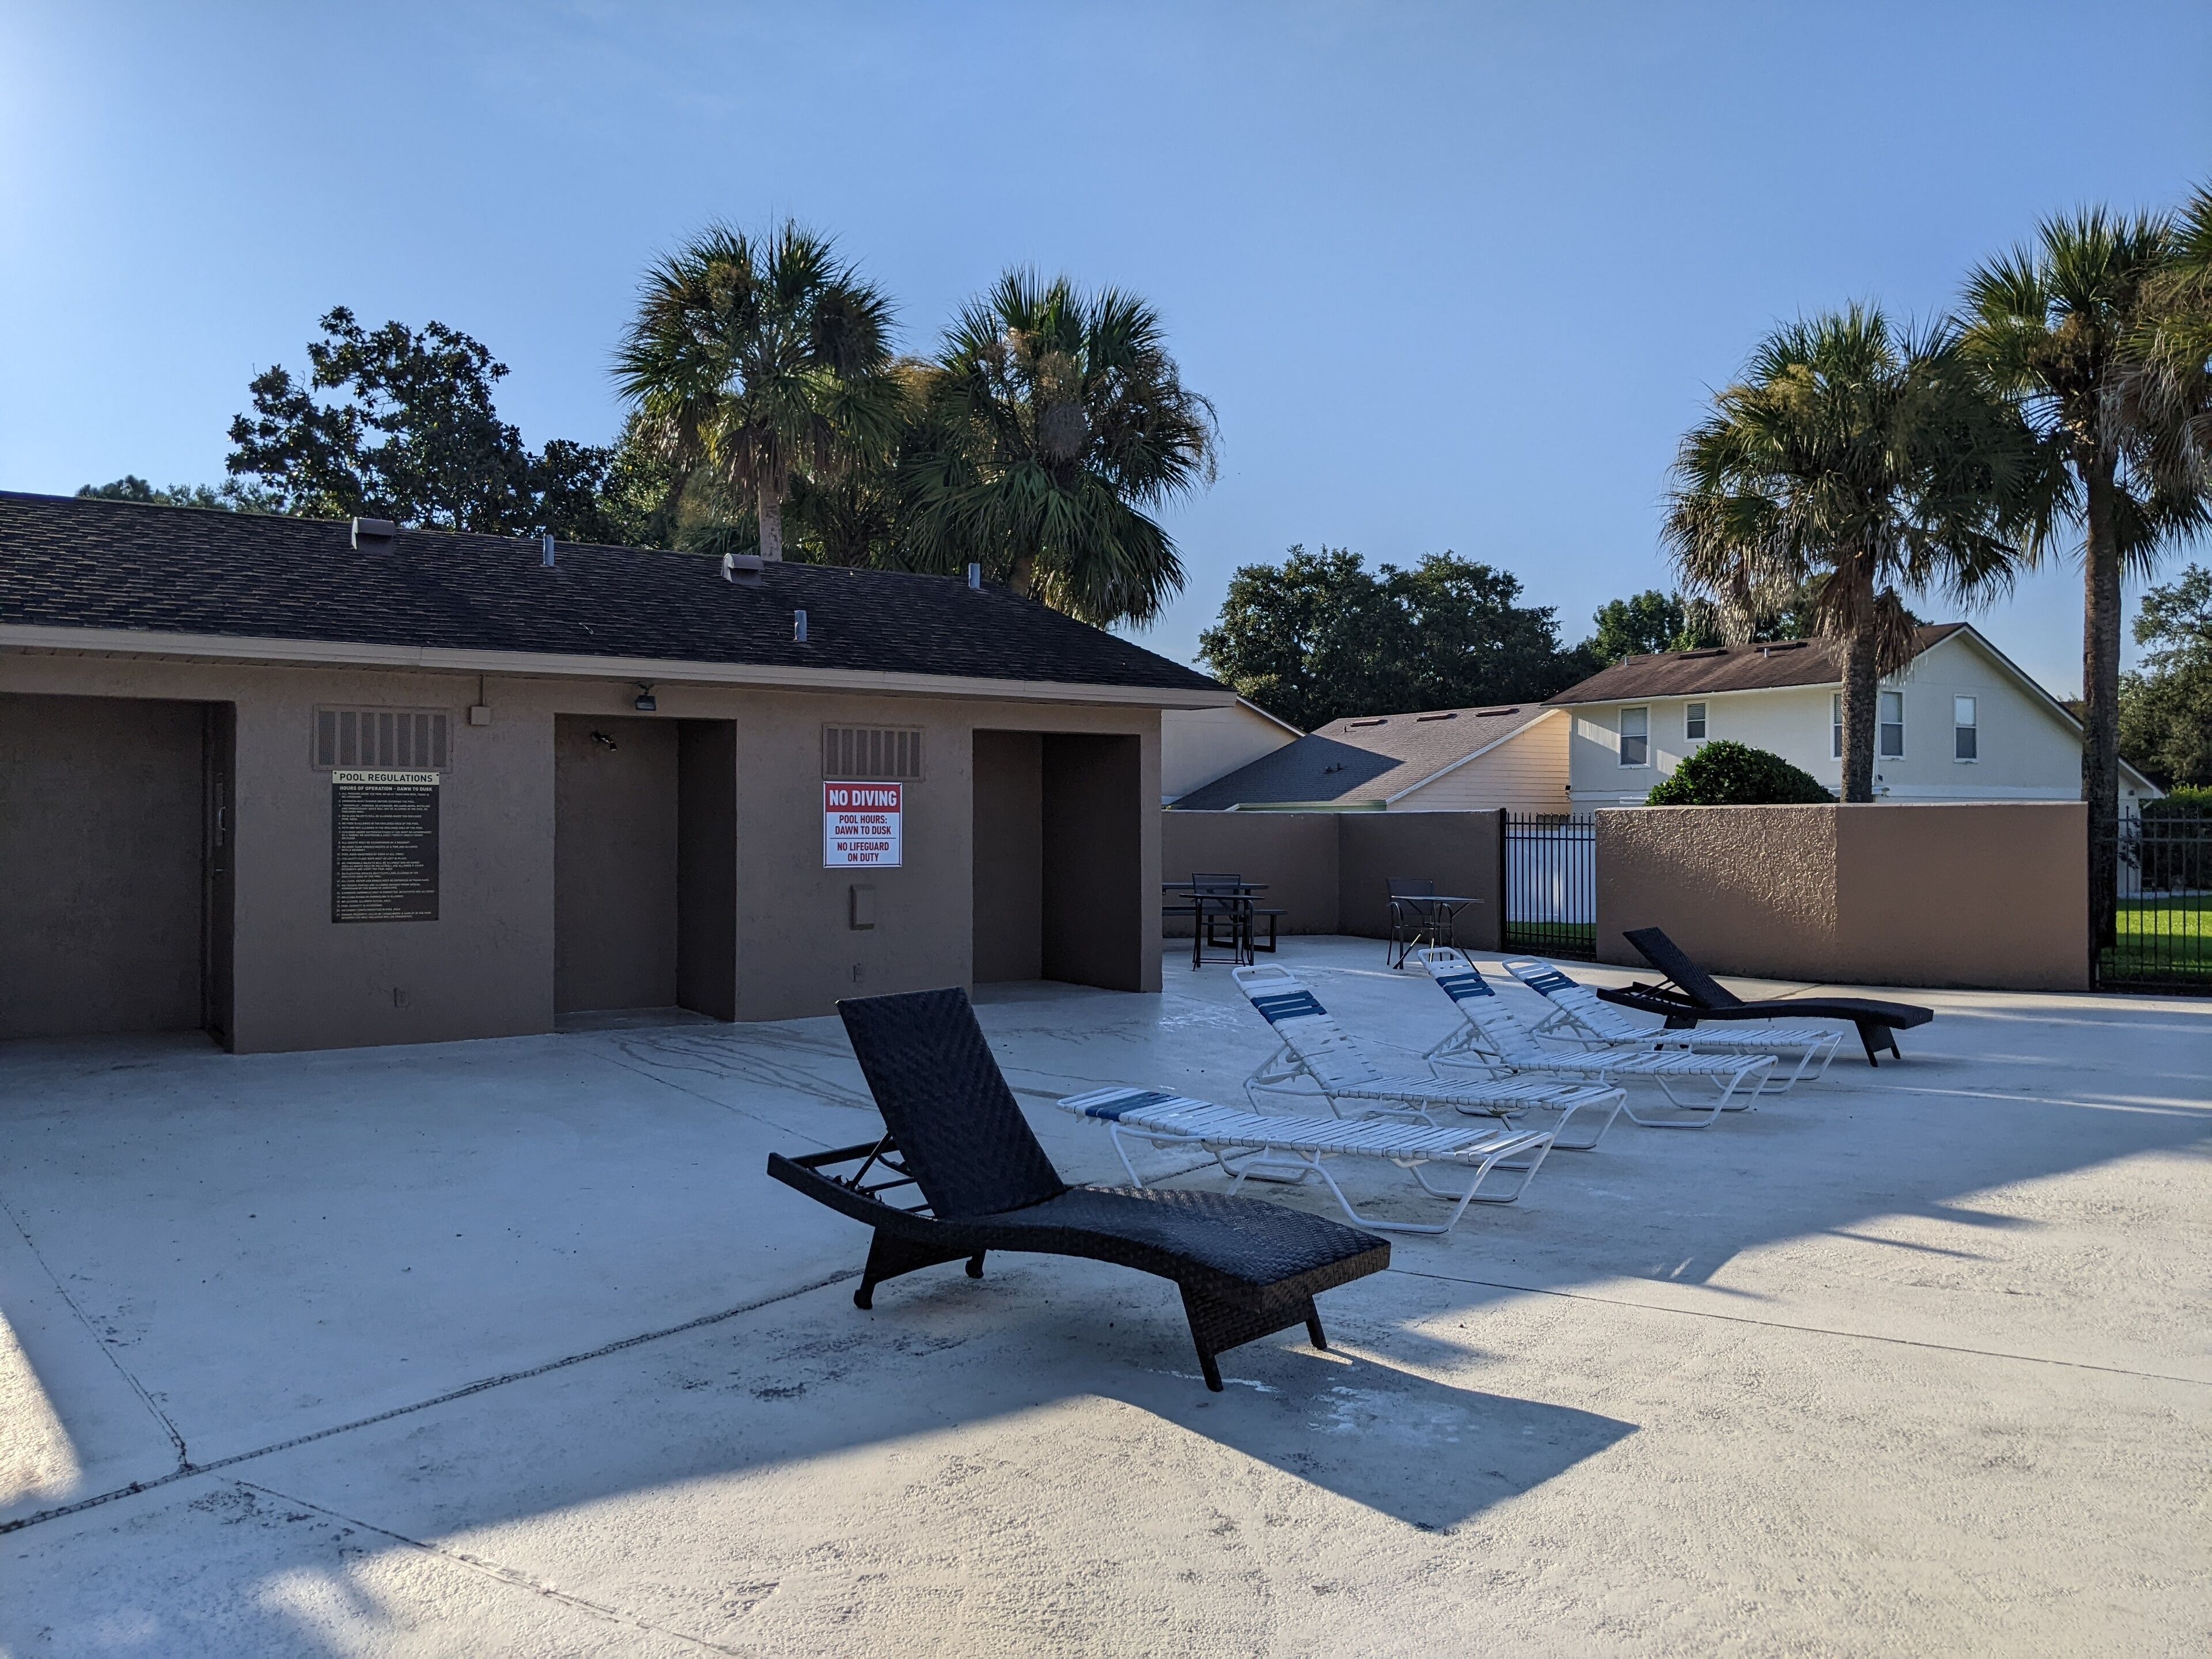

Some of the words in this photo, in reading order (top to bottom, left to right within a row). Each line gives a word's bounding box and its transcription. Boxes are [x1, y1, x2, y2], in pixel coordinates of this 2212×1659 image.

[340, 773, 365, 781] POOL
[368, 774, 433, 782] REGULATIONS
[830, 790, 848, 806] NO
[852, 790, 897, 806] DIVING
[839, 815, 858, 824] POOL
[860, 815, 887, 824] HOURS:
[835, 826, 858, 835] DAWN
[861, 826, 869, 835] TO
[872, 826, 891, 835] DUSK
[838, 842, 847, 851] NO
[850, 842, 889, 851] LIFEGUARD
[848, 853, 858, 862] ON
[860, 853, 879, 862] DUTY
